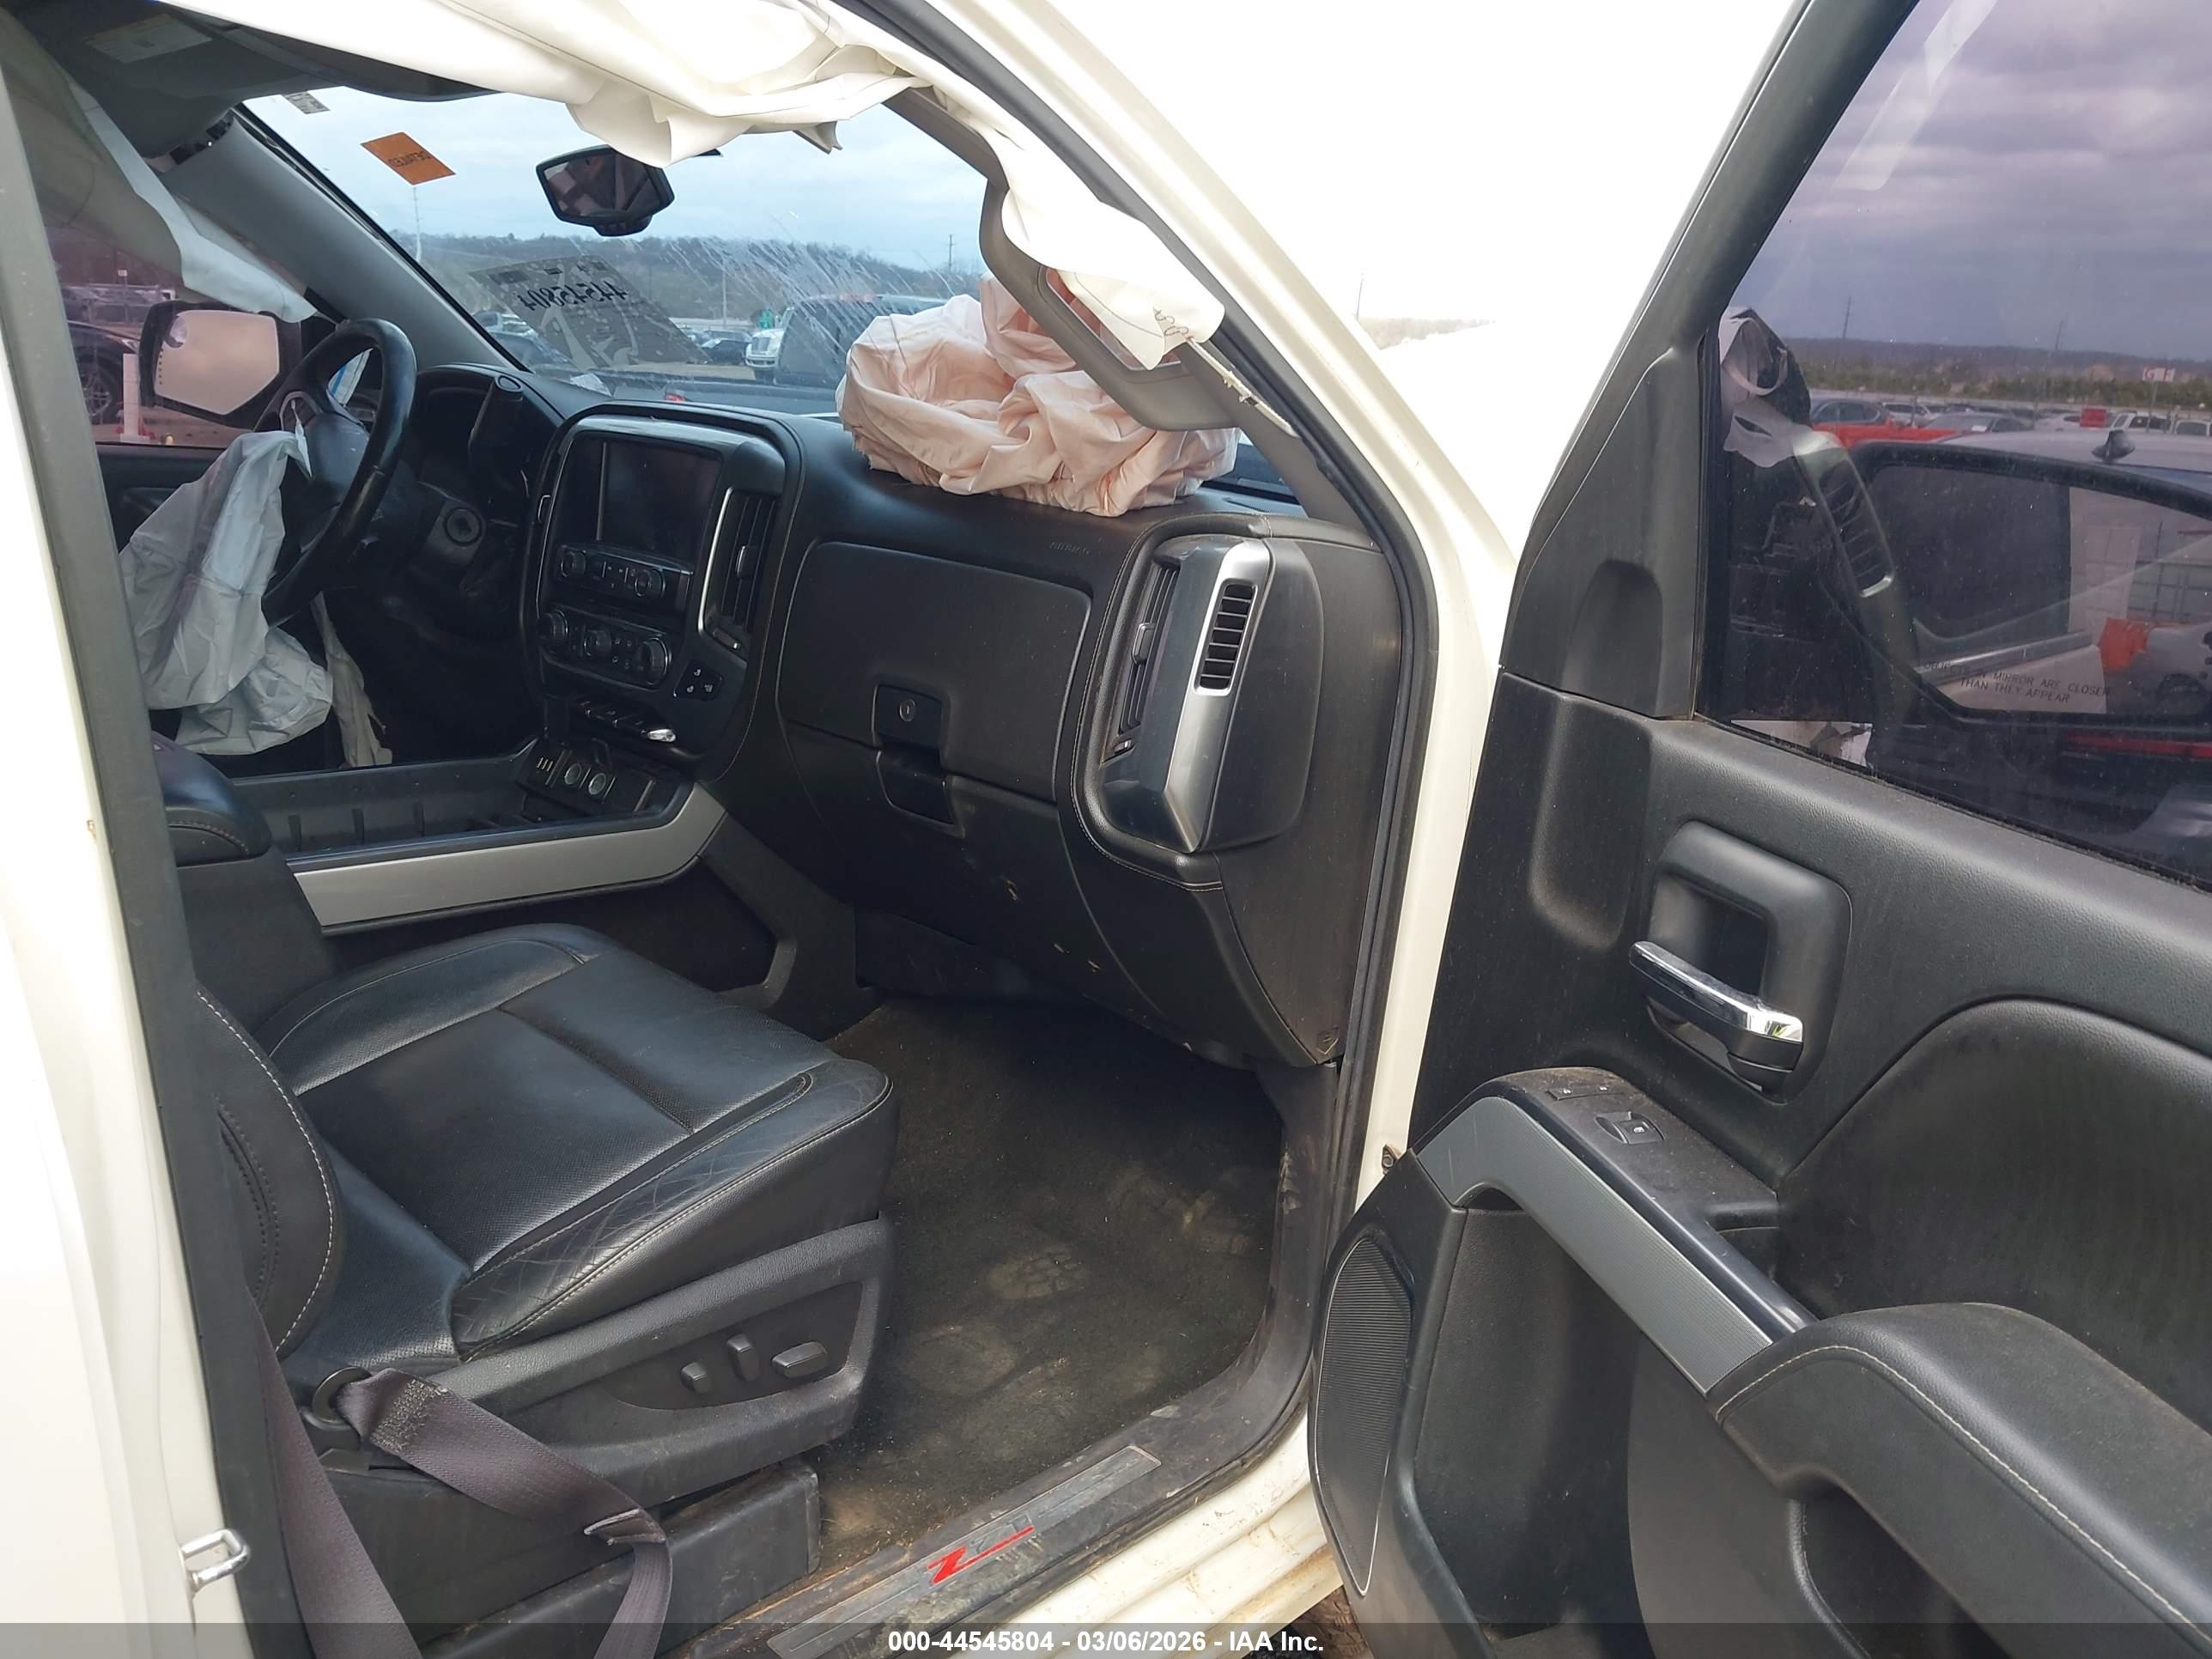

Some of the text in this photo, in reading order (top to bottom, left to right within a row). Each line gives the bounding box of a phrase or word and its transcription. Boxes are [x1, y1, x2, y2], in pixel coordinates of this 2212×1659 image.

[1960, 678, 2070, 703] THAN THEY APPEAR
[1992, 671, 2034, 686] MIRROR
[2040, 679, 2061, 690] ARE
